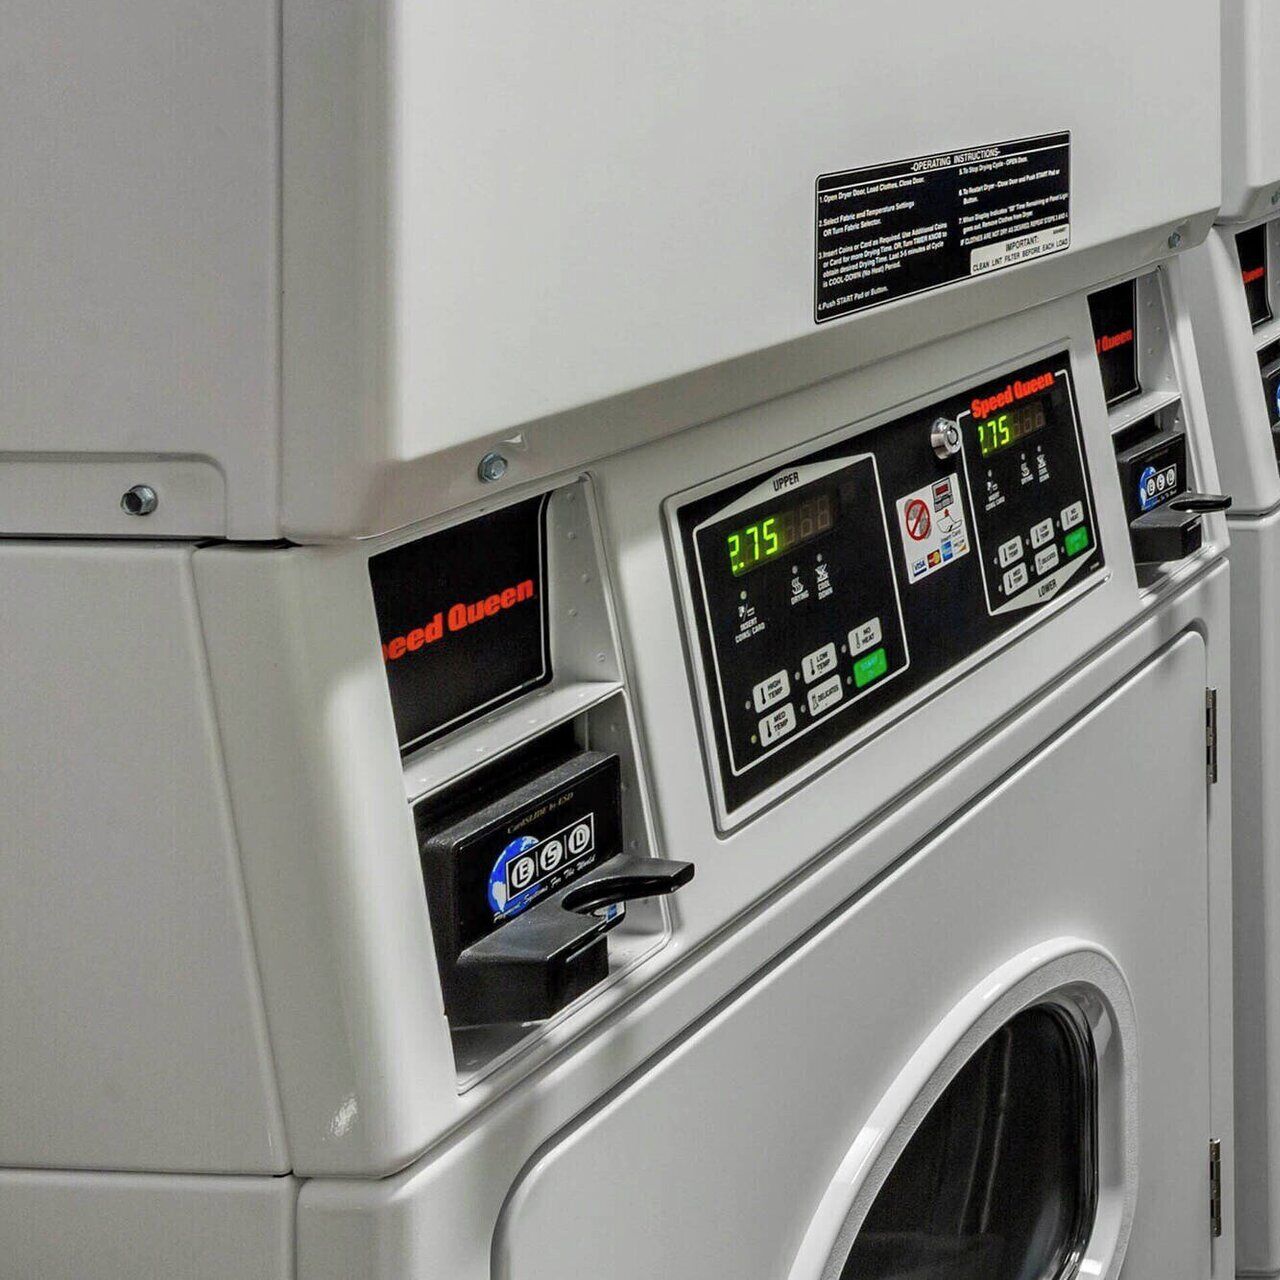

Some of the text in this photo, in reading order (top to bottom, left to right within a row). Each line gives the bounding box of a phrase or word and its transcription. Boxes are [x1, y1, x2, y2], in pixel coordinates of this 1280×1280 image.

[971, 372, 1055, 419] Speed Queen
[773, 471, 799, 492] UPPER
[1038, 579, 1057, 598] LOWER
[382, 579, 533, 660] eed Queen
[816, 651, 828, 663] LOW
[816, 658, 831, 671] TEMP
[767, 678, 781, 691] HIGH
[768, 687, 783, 700] TEMP
[773, 711, 786, 722] MED
